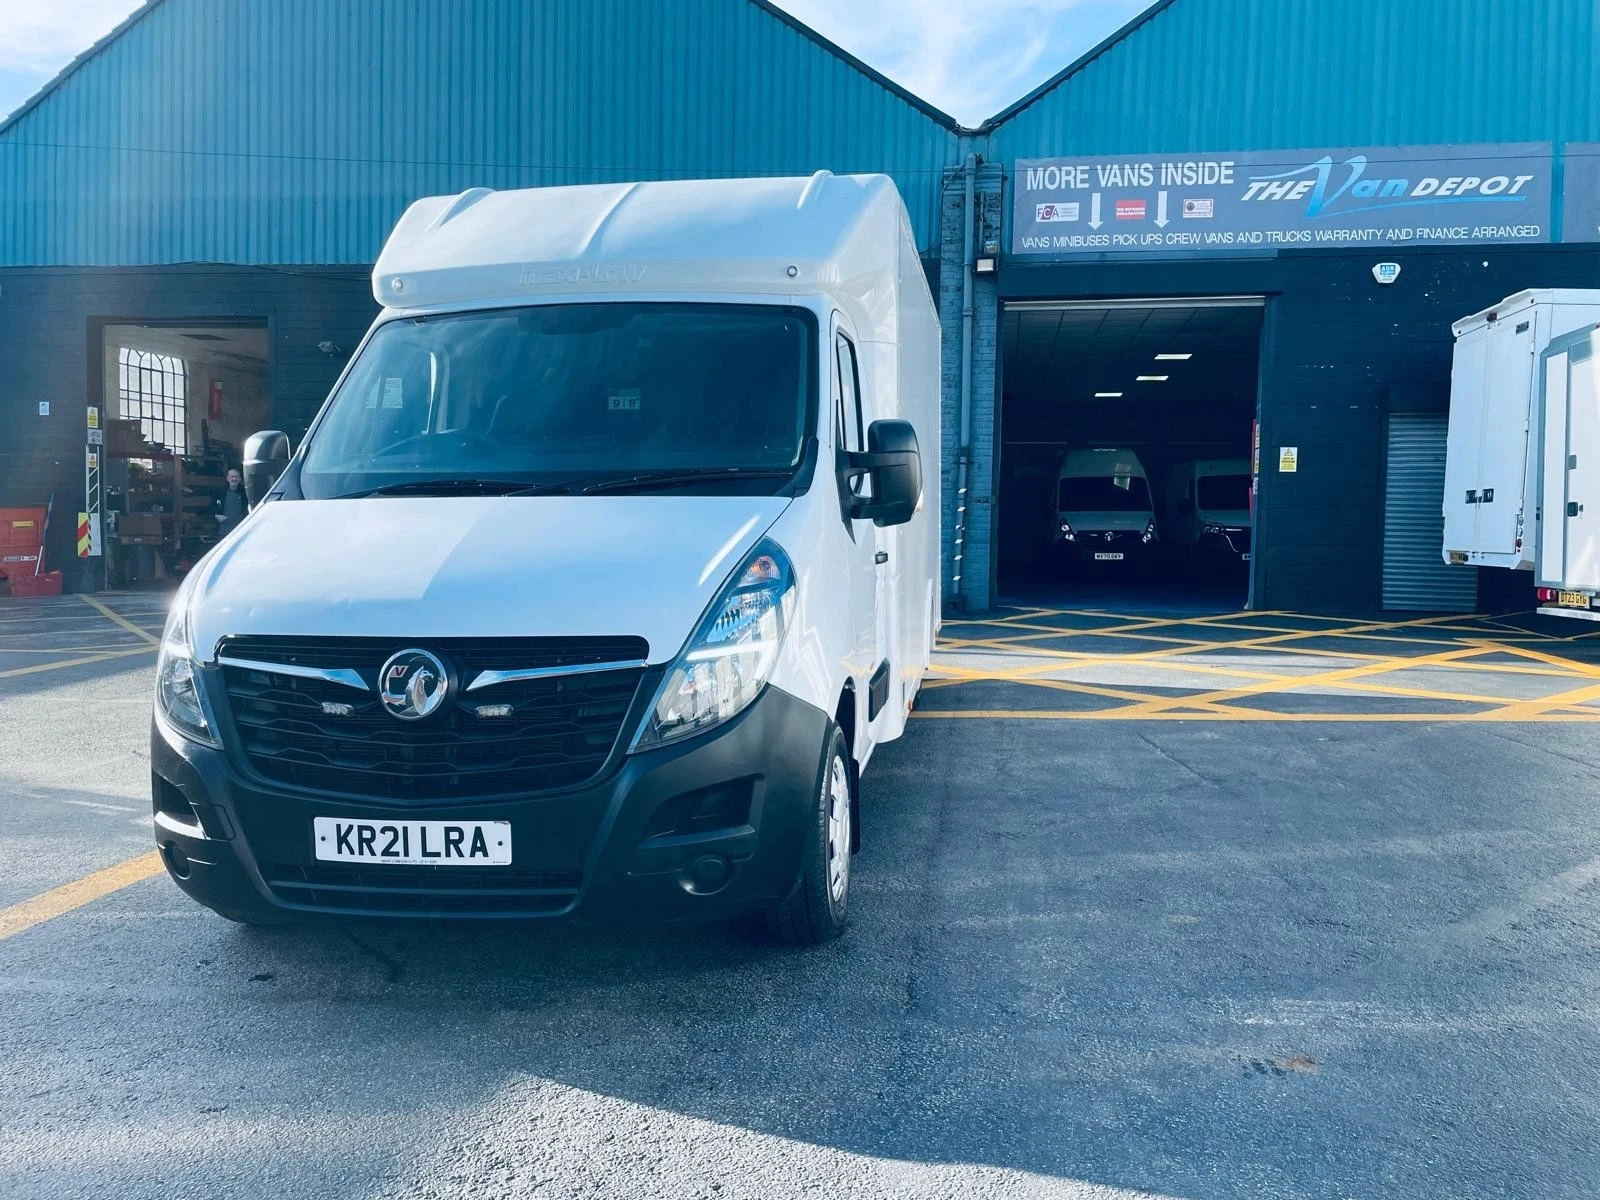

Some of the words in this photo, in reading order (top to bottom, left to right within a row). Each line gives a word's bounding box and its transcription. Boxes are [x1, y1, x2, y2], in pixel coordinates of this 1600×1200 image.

[1026, 166, 1090, 191] MORE
[1097, 163, 1154, 187] VANS
[1160, 161, 1235, 186] INSIDE
[1240, 180, 1317, 200] THE
[1303, 155, 1409, 217] Van
[1410, 174, 1534, 197] DEPOT
[1037, 205, 1060, 220] FCA
[1022, 236, 1050, 248] VANS
[1053, 234, 1110, 247] MINIBUSES
[1112, 233, 1138, 246] PICK
[1140, 233, 1163, 245] UPS
[1165, 232, 1202, 245] CREW
[1204, 231, 1234, 243] VANS
[1236, 230, 1264, 243] AND
[1265, 229, 1312, 243] TRUCKS
[1315, 228, 1383, 241] WARRANTY
[1385, 227, 1413, 240] AND
[1416, 226, 1469, 239] FINANCE
[1471, 225, 1541, 238] ARRANGED
[336, 823, 410, 858] KR21
[420, 826, 489, 858] LRA
